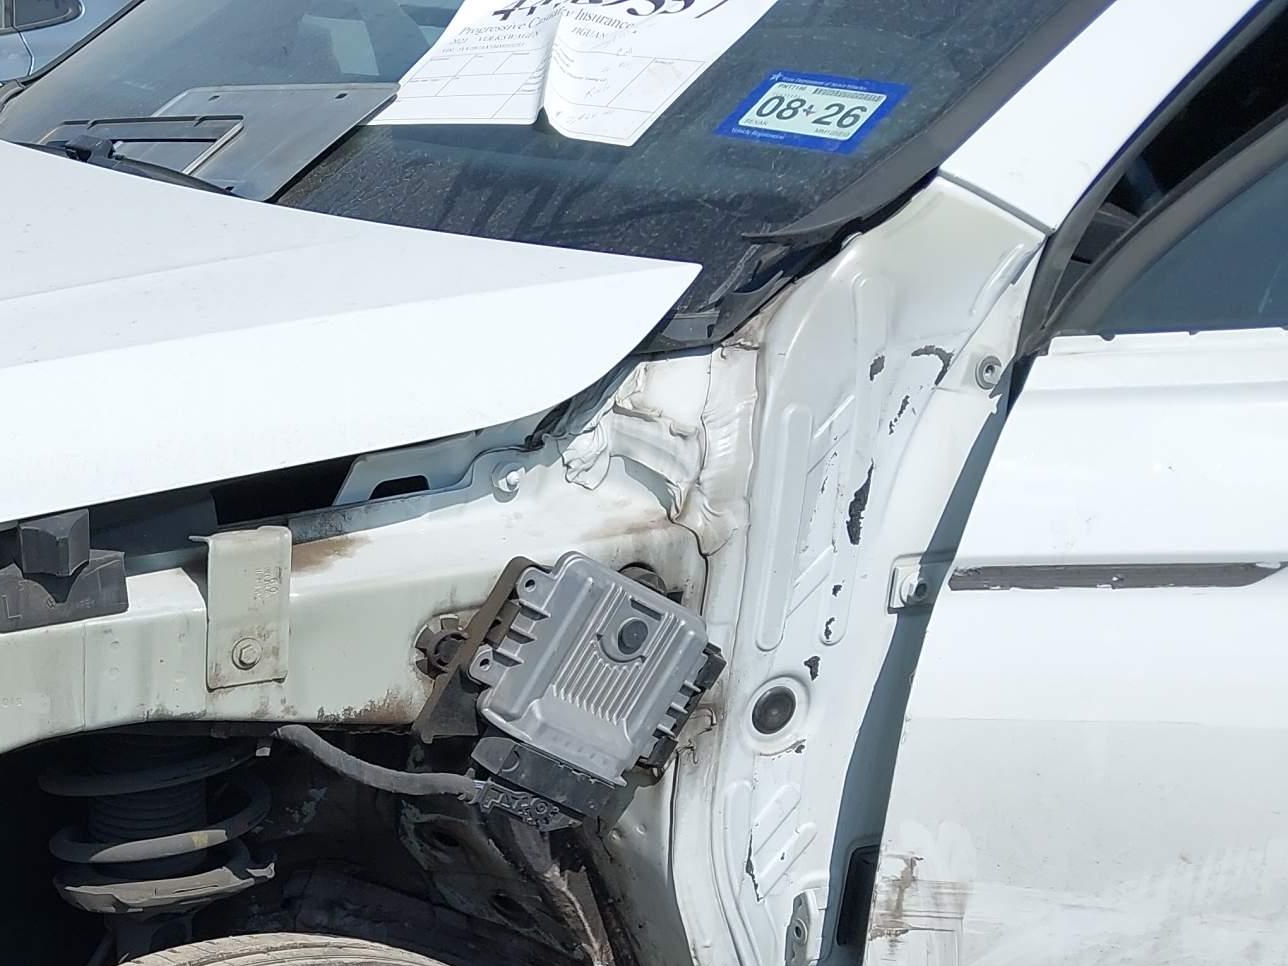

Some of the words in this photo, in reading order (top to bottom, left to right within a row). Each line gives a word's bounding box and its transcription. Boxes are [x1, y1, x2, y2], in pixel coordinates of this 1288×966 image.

[460, 22, 527, 36] Progressive
[756, 95, 807, 121] 08
[812, 102, 868, 129] 26
